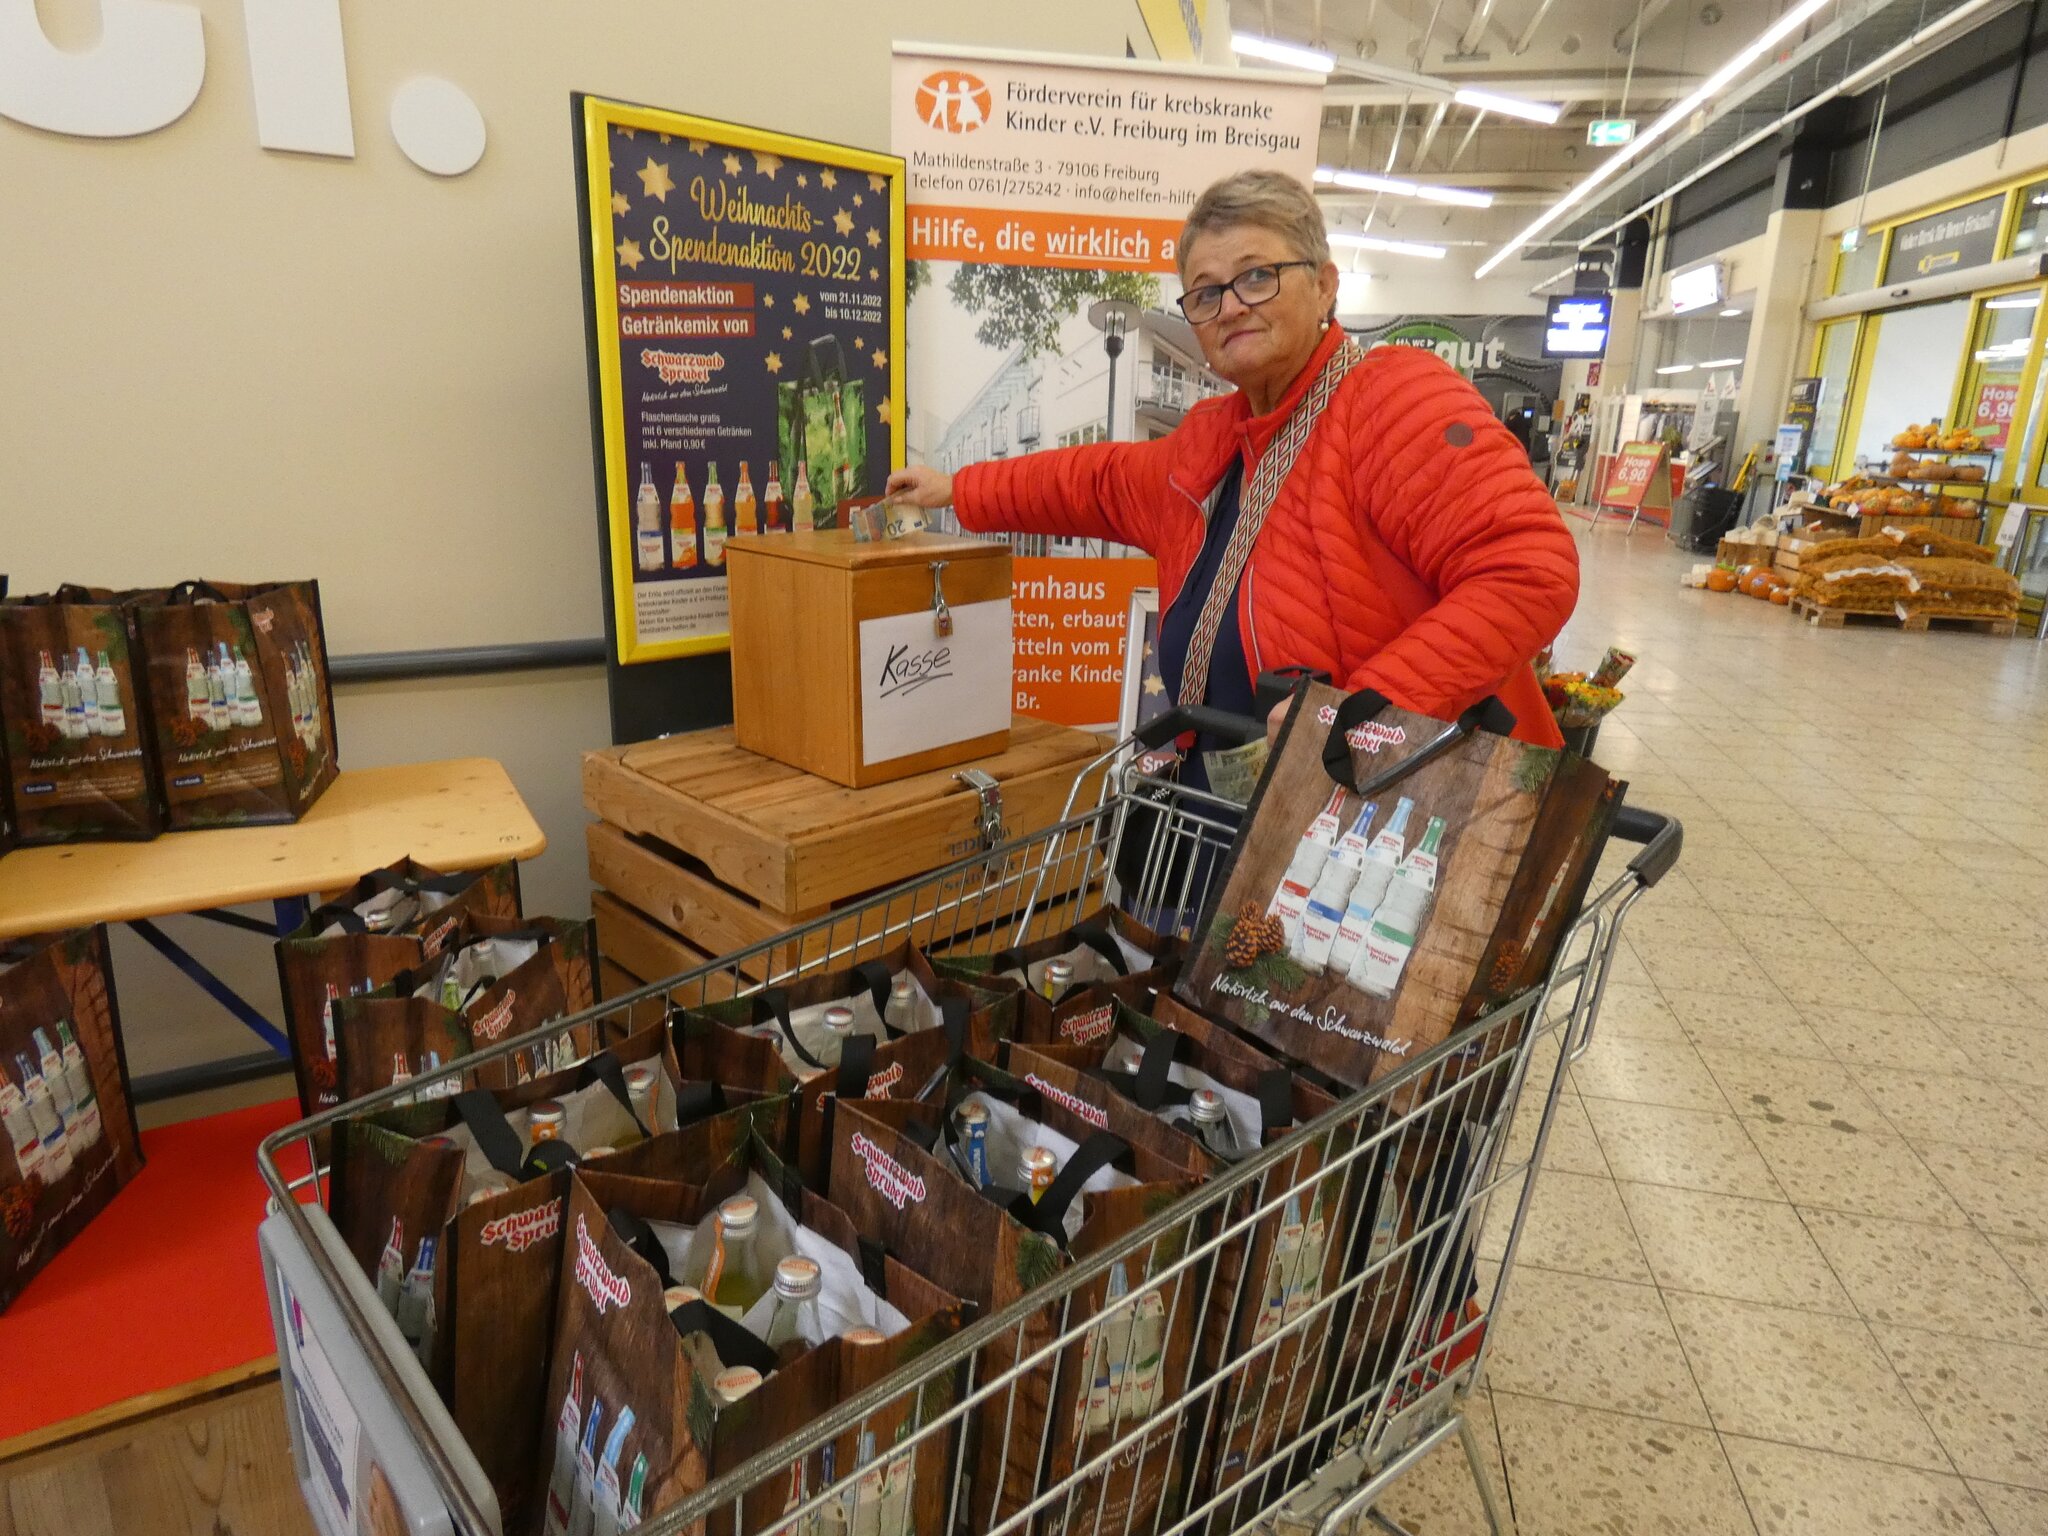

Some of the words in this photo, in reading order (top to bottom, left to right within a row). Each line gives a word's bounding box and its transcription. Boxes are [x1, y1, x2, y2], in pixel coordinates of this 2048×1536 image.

[1007, 81, 1122, 109] Förderverein
[1130, 91, 1158, 112] für
[1164, 96, 1273, 121] krebskranke
[1006, 110, 1067, 134] Kinder
[1074, 116, 1105, 138] e.V.
[1113, 119, 1188, 148] Freiburg
[1195, 125, 1217, 144] im
[1225, 127, 1301, 152] Breisgau
[912, 151, 1030, 174] Mathildenstraße
[1034, 159, 1043, 174] 3
[1057, 161, 1099, 179] 79106
[1104, 164, 1160, 186] Freiburg
[912, 173, 964, 192] Telefon
[968, 176, 1062, 199] 0761/275242
[690, 175, 823, 233] Weihnachts-
[650, 215, 795, 275] Spendenaktion
[801, 241, 862, 281] 2022
[912, 218, 985, 252] Hilfe,
[995, 222, 1036, 253] die
[1046, 225, 1150, 260] wirklich
[1161, 238, 1176, 260] a
[620, 285, 734, 307] Spendenaktion
[820, 292, 837, 303] vom
[839, 291, 882, 308] 21.11.2022
[622, 315, 719, 335] Getränkemix
[723, 318, 749, 334] von
[825, 307, 838, 319] bis
[839, 309, 882, 323] 10.12.2022
[641, 349, 724, 370] Schwarzwald
[659, 366, 710, 386] Sprudel
[641, 410, 699, 423] Flaschentasche
[700, 413, 720, 424] gratis
[642, 425, 655, 436] mit
[656, 425, 662, 436] 6
[663, 426, 716, 437] verschiedenen
[717, 426, 752, 437] Getränken
[643, 438, 659, 449] inkl.
[661, 438, 682, 449] Pfand
[683, 439, 700, 450] 0,90
[1624, 456, 1651, 468] Hose
[1617, 467, 1647, 483] 6,90
[1063, 609, 1126, 628] erbaut
[1071, 642, 1110, 655] vom
[879, 645, 951, 687] Kasse
[1071, 664, 1122, 684] Kinde
[1016, 691, 1041, 710] Br.
[1345, 731, 1381, 754] rudel
[1210, 973, 1269, 1006] Natürlich
[1269, 1000, 1291, 1013] aus
[1290, 1004, 1314, 1025] dem
[1317, 1005, 1412, 1057] Schwarzwald
[851, 1132, 926, 1203] Schwarzwald
[864, 1161, 906, 1210] Sprudel
[576, 1212, 631, 1308] Schwarzwald
[576, 1256, 607, 1315] Sprudel
